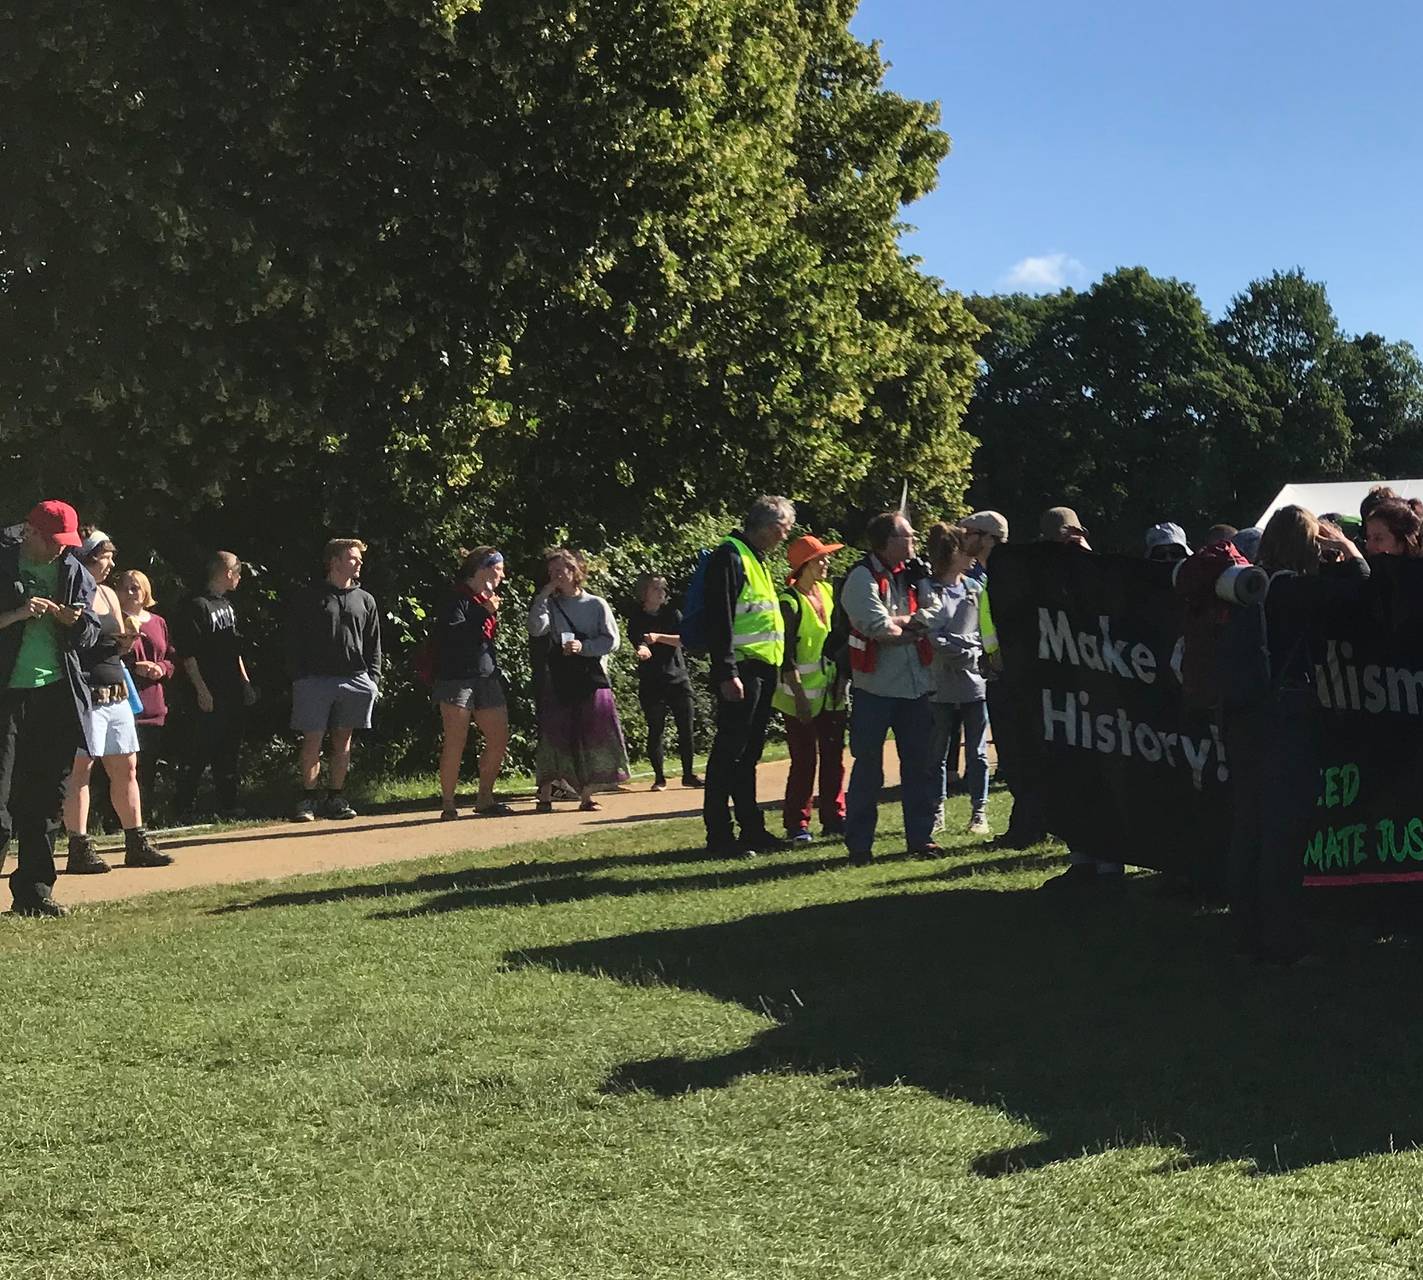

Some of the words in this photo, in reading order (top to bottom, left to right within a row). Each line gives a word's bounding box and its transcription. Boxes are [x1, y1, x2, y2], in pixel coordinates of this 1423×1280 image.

[1038, 607, 1156, 684] Make
[1042, 688, 1229, 792] History!
[1303, 823, 1369, 872] MATE
